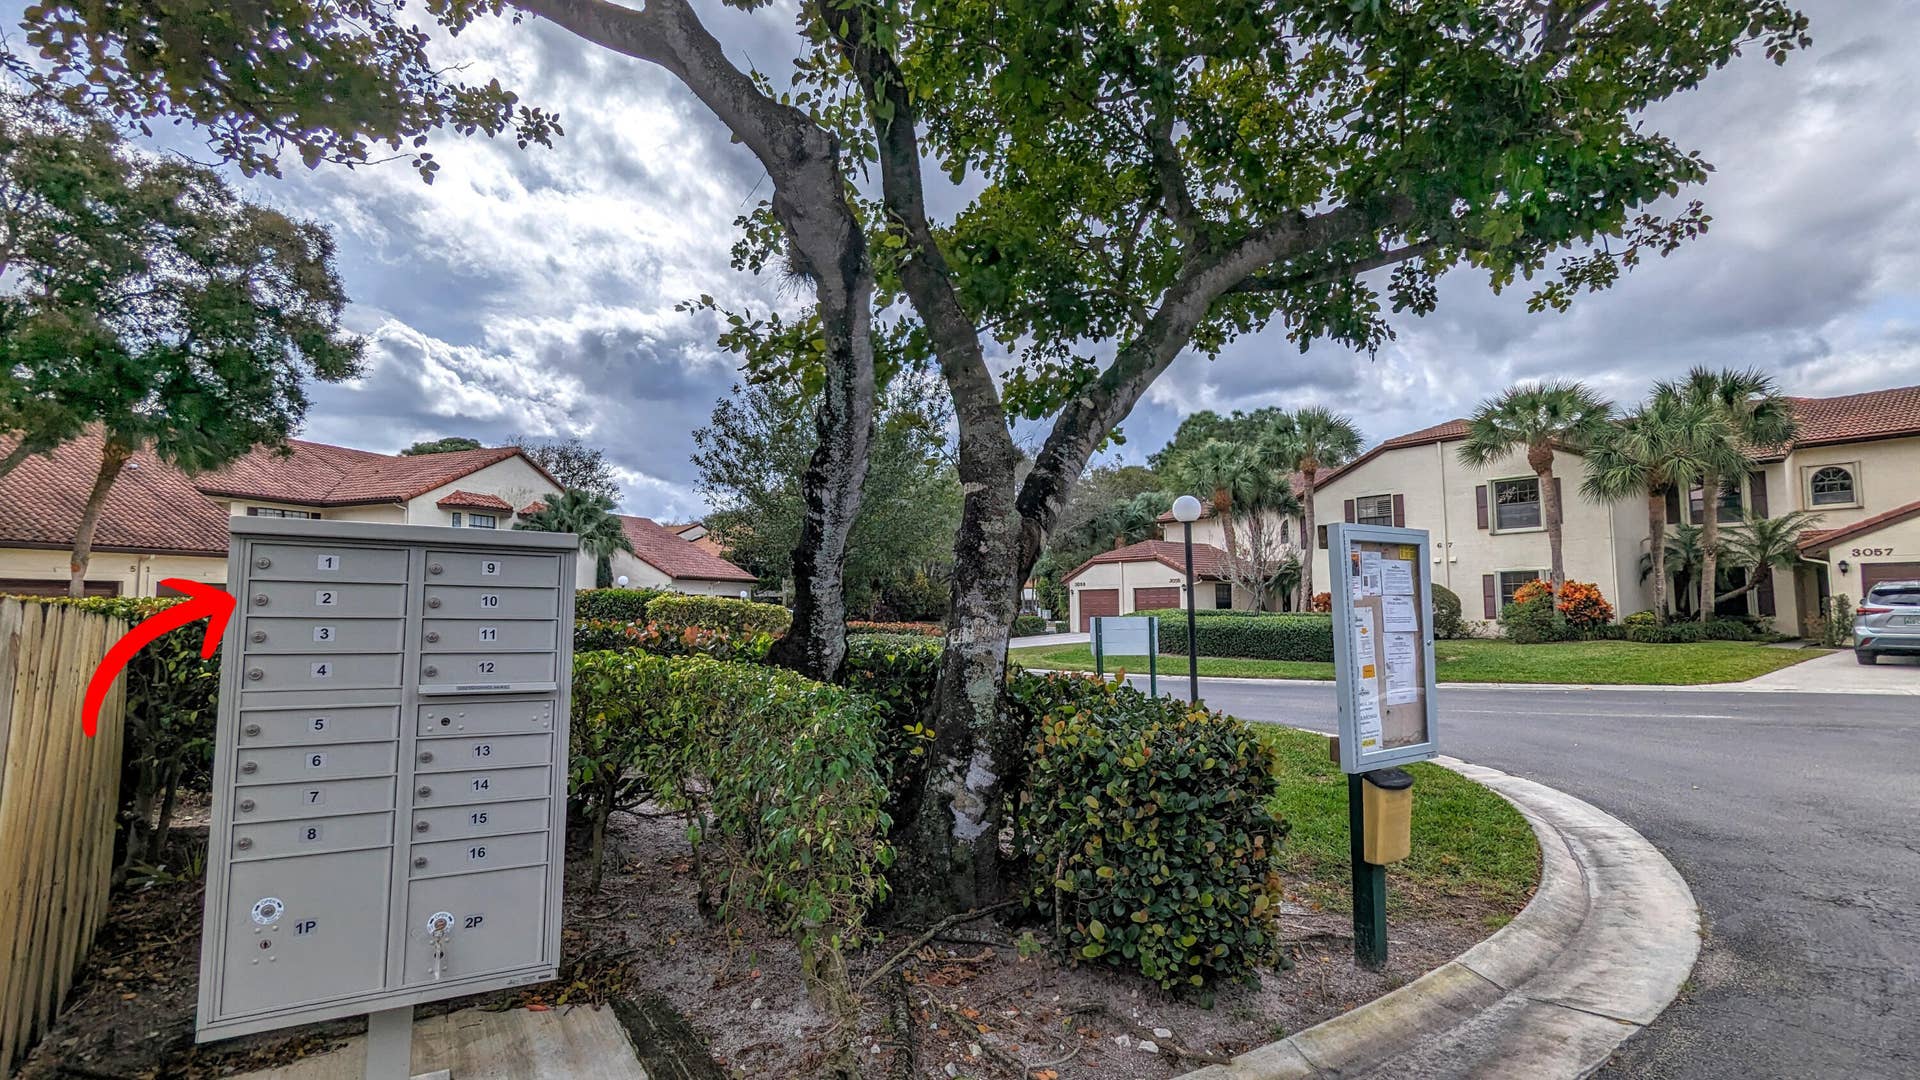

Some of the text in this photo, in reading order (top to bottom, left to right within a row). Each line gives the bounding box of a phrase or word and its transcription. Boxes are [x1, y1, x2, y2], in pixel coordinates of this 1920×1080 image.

[1852, 547, 1894, 557] 3057
[325, 557, 333, 569] 1
[487, 562, 496, 574] 9
[322, 592, 332, 604] 2
[482, 596, 498, 607] 10
[319, 628, 329, 640] 3
[481, 629, 496, 640] 11
[316, 664, 326, 676] 4
[479, 662, 495, 673] 12
[314, 718, 324, 731] 5
[475, 745, 491, 757] 13
[312, 754, 321, 767] 6
[473, 779, 489, 791] 14
[310, 791, 320, 803] 7
[471, 812, 487, 824] 15
[307, 828, 317, 840] 8
[470, 847, 486, 859] 16
[295, 920, 317, 935] 1P
[464, 915, 483, 929] 2P
